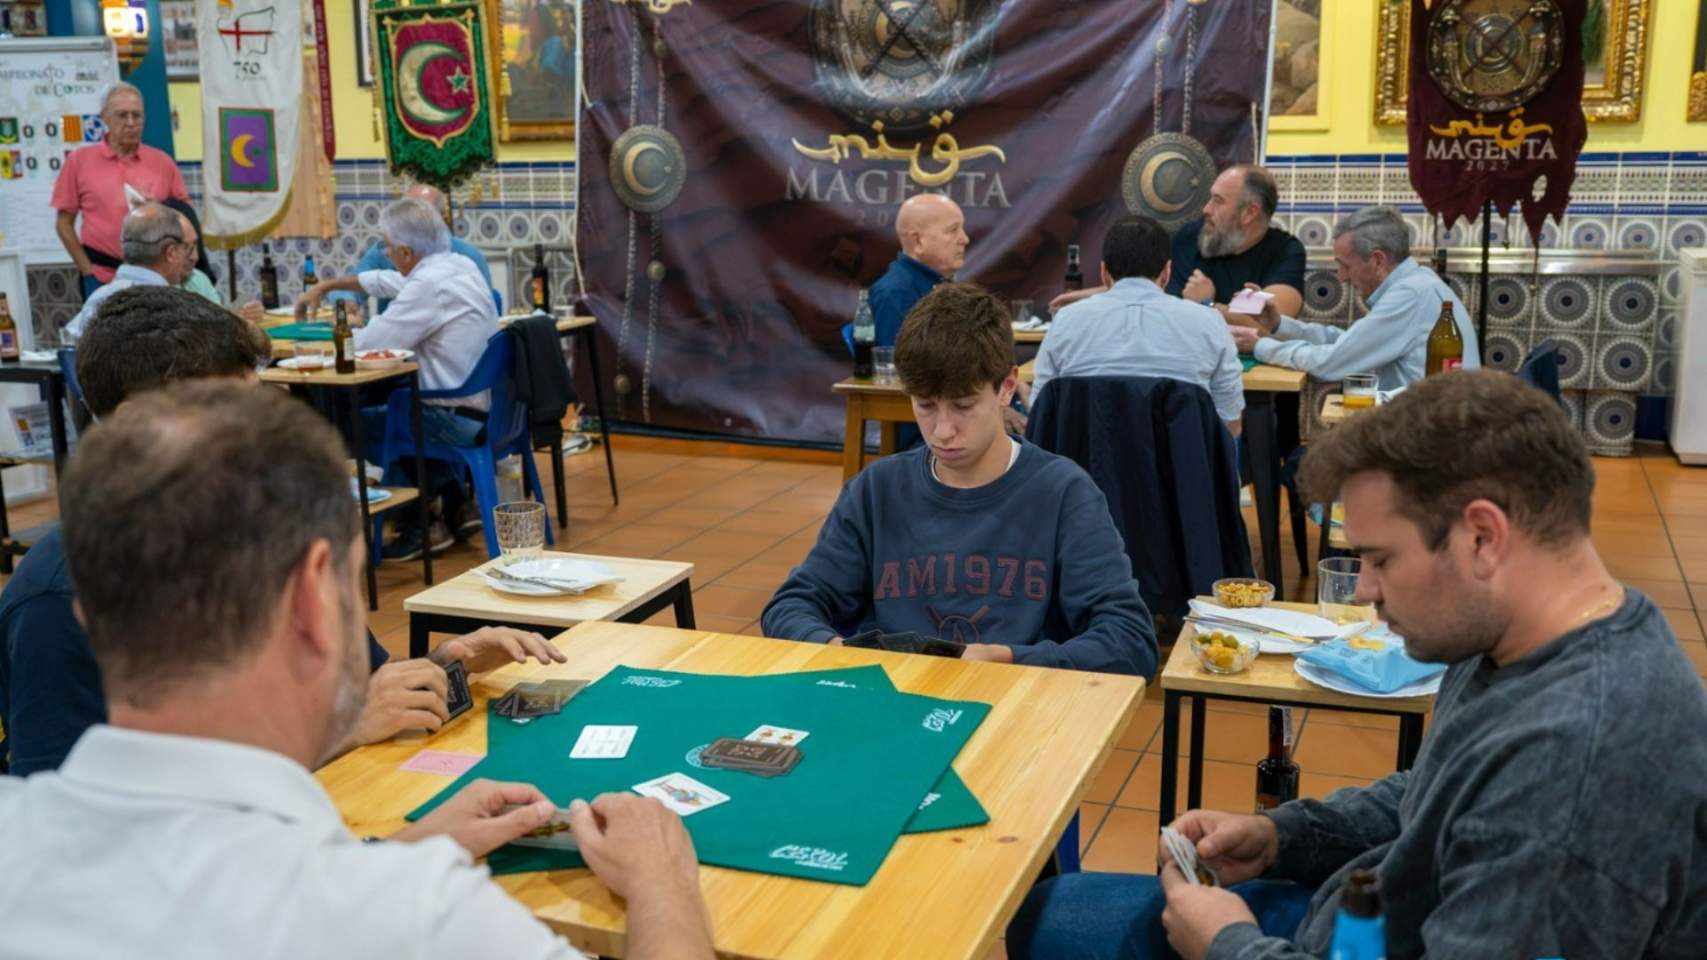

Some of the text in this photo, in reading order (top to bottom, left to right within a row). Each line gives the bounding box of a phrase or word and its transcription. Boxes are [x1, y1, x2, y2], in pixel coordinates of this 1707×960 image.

[232, 60, 261, 80] 750
[23, 122, 57, 138] 0 0
[1426, 138, 1558, 160] MAGENTA
[26, 156, 60, 170] 0 0
[874, 553, 1047, 600] AM1976
